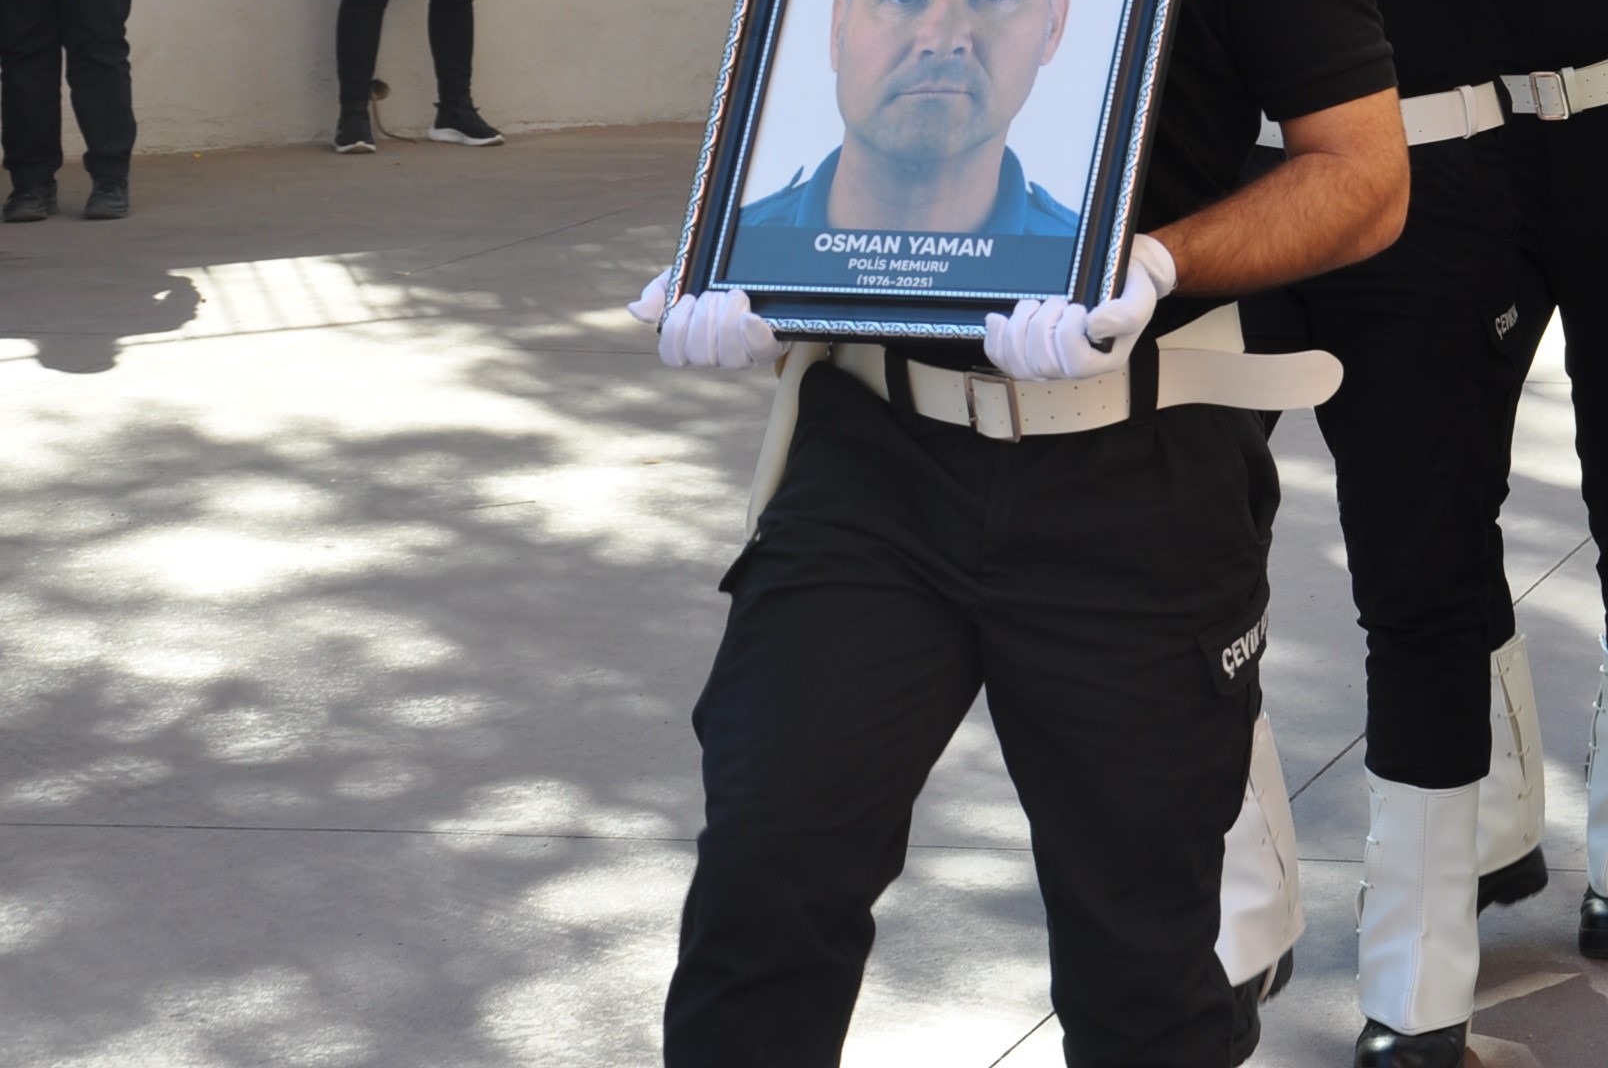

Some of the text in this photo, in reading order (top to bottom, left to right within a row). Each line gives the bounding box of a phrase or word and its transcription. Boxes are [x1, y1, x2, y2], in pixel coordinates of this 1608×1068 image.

[814, 233, 994, 258] OSMAN YAMAN
[847, 256, 949, 273] POLİS MEMURU
[856, 274, 933, 288] (1976-2025)
